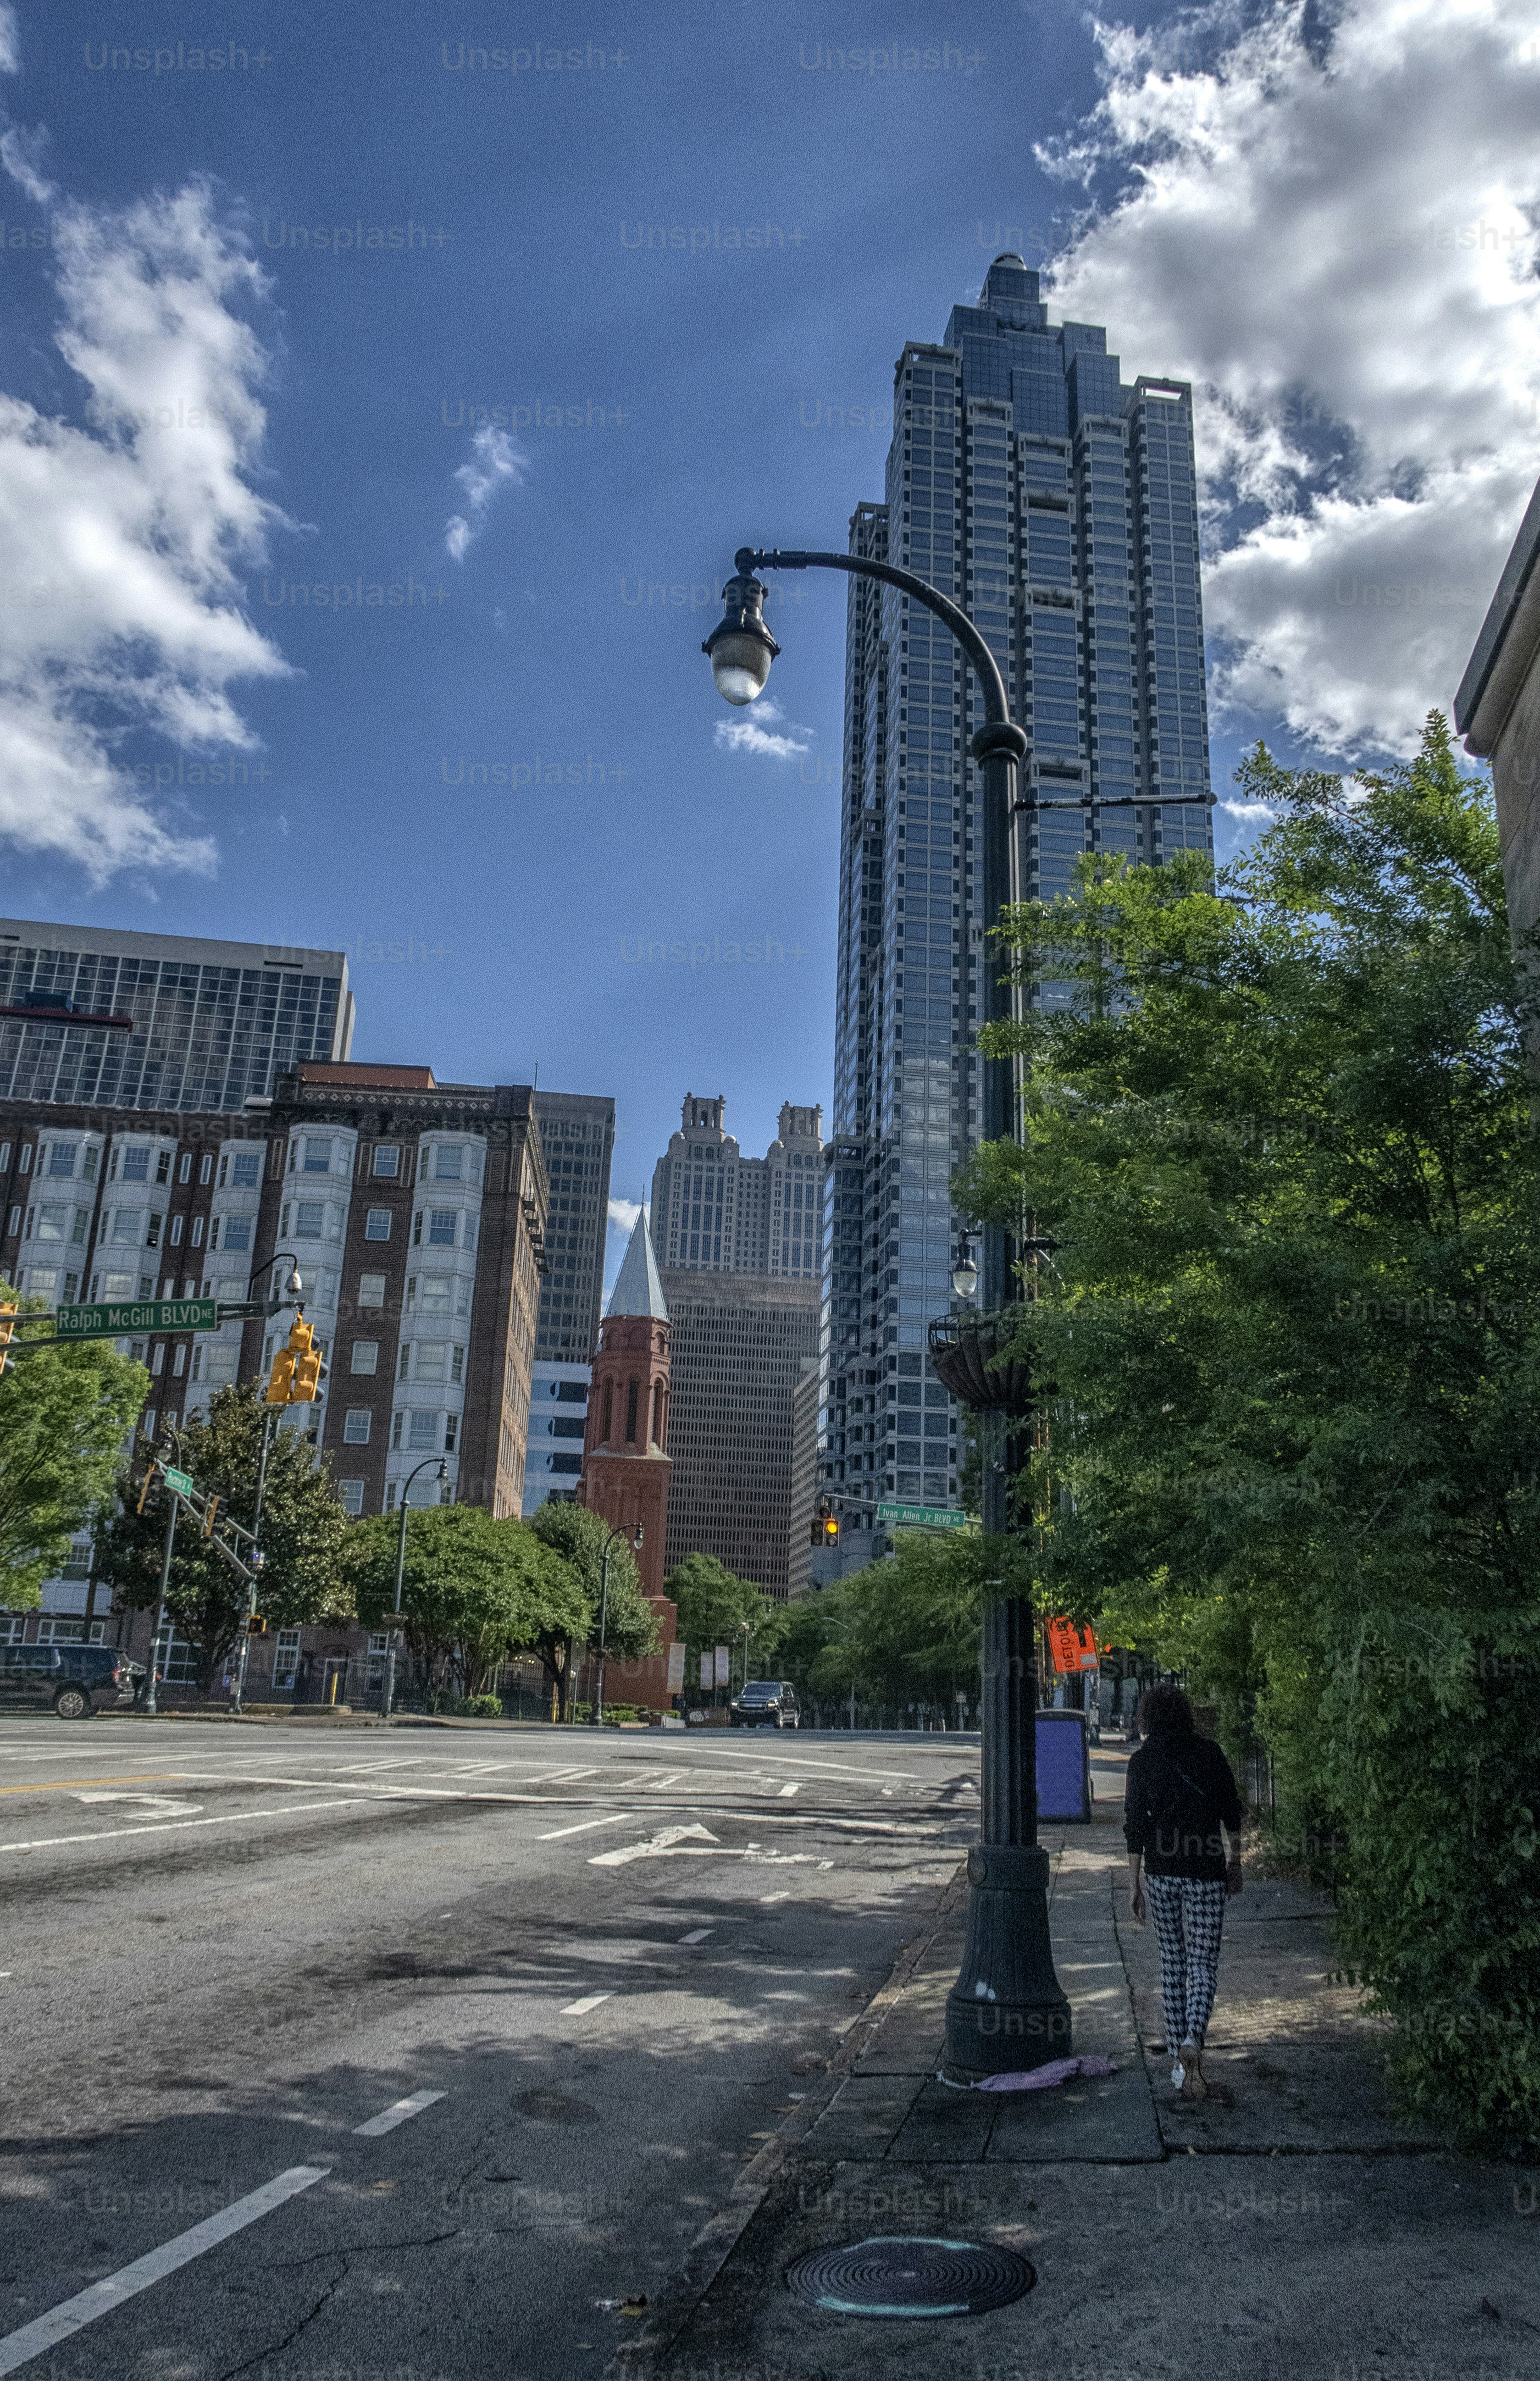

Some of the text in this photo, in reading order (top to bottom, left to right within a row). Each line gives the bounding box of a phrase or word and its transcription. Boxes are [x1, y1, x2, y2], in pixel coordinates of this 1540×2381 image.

[59, 1305, 213, 1332] Ralph McGill BLVD NE
[883, 1508, 898, 1519] Ivan
[902, 1510, 920, 1521] Allen
[923, 1512, 931, 1523] Jr
[934, 1513, 951, 1524] BLVD
